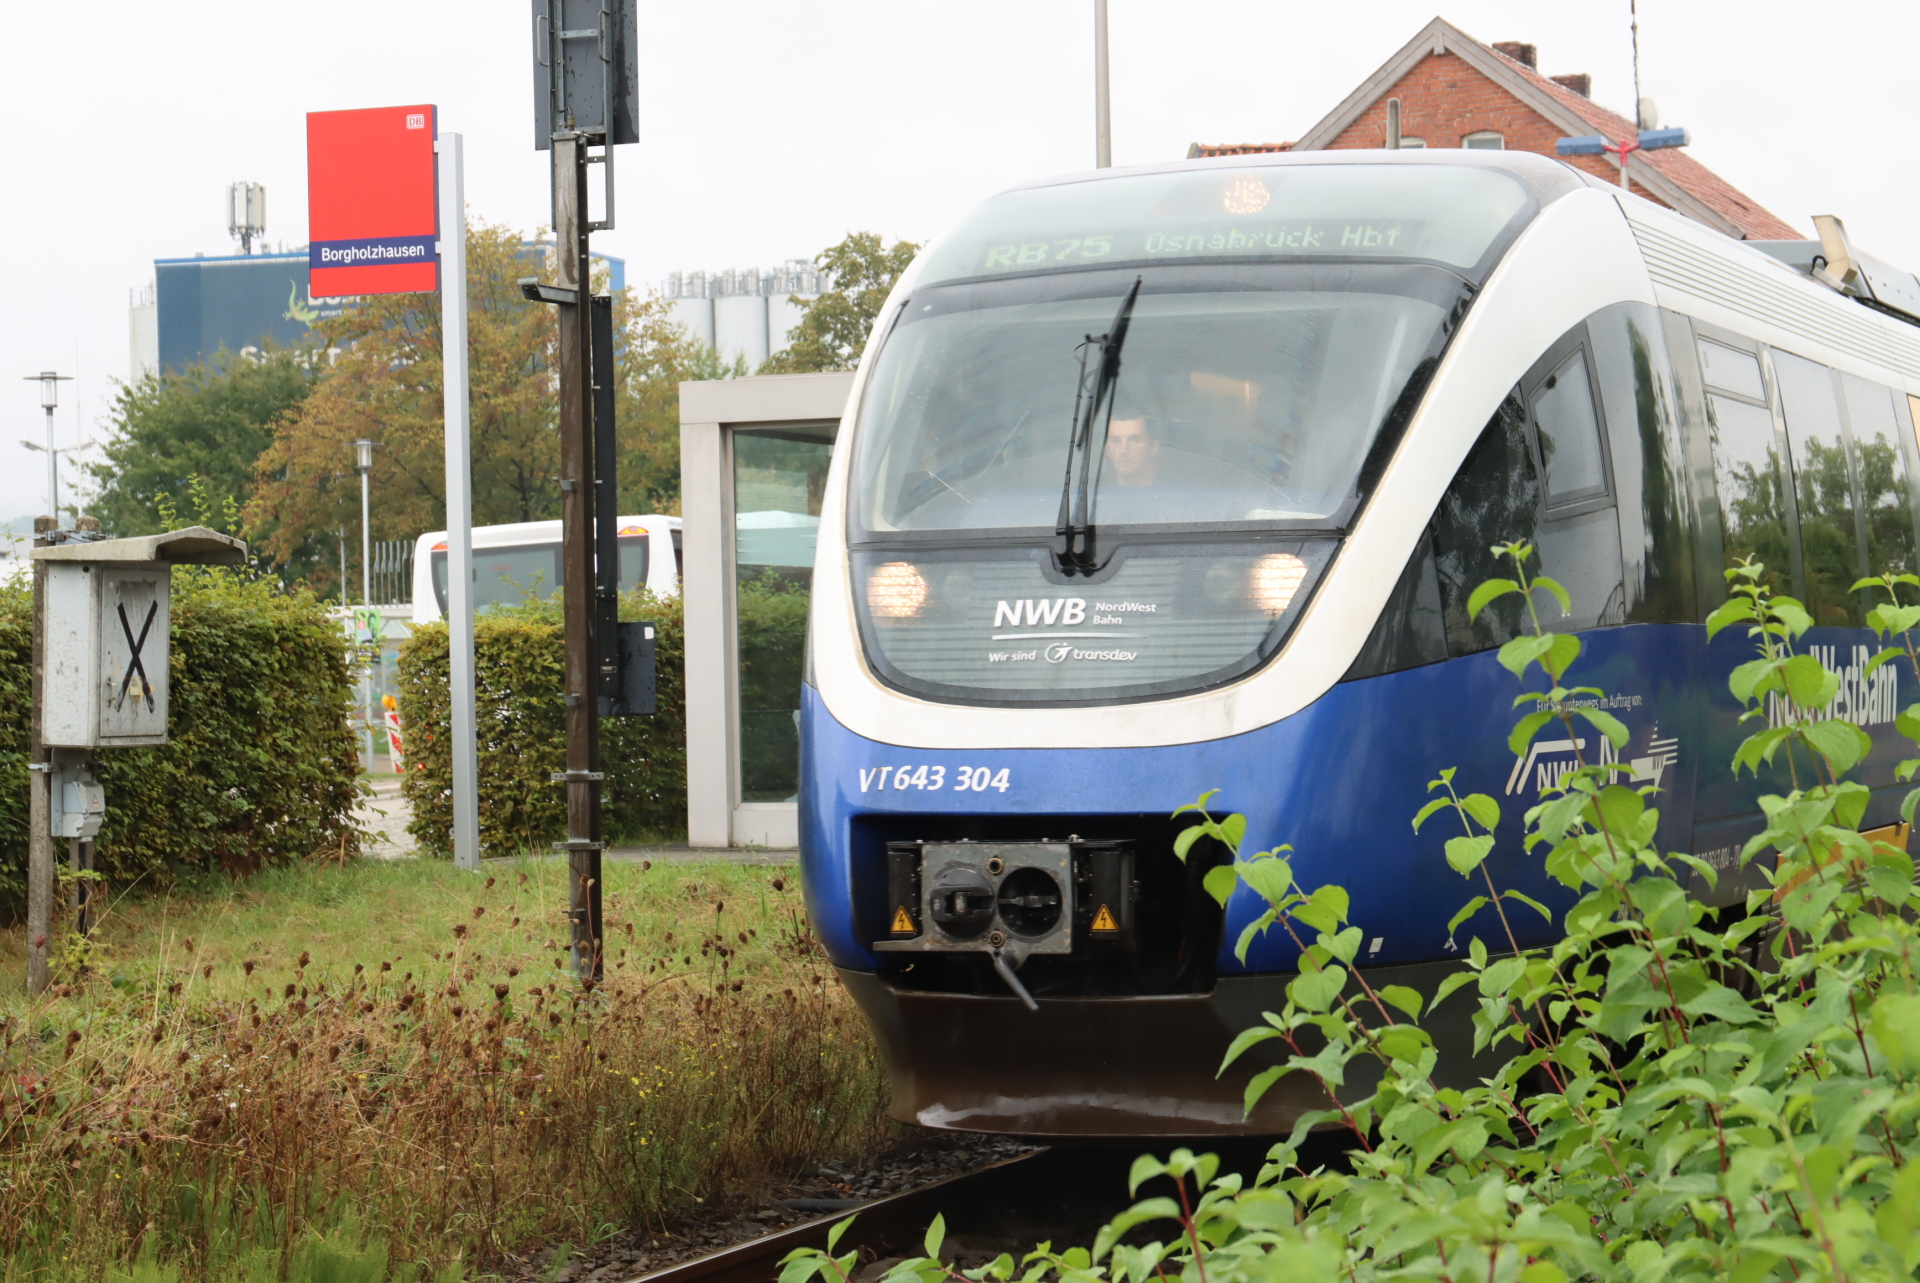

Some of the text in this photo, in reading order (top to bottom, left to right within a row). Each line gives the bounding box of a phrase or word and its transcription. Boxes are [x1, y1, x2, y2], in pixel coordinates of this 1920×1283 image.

[408, 117, 422, 126] DB
[321, 244, 425, 263] Borgholzhausen
[984, 225, 1403, 269] RB75 Osnabrück Hbf
[993, 598, 1157, 627] NWB NordWest
[1093, 614, 1123, 625] Bahn
[988, 649, 1138, 662] Wir sind transdev
[1609, 692, 1632, 712] Auftrag
[953, 765, 1011, 793] 304
[1537, 759, 1579, 792] NW
